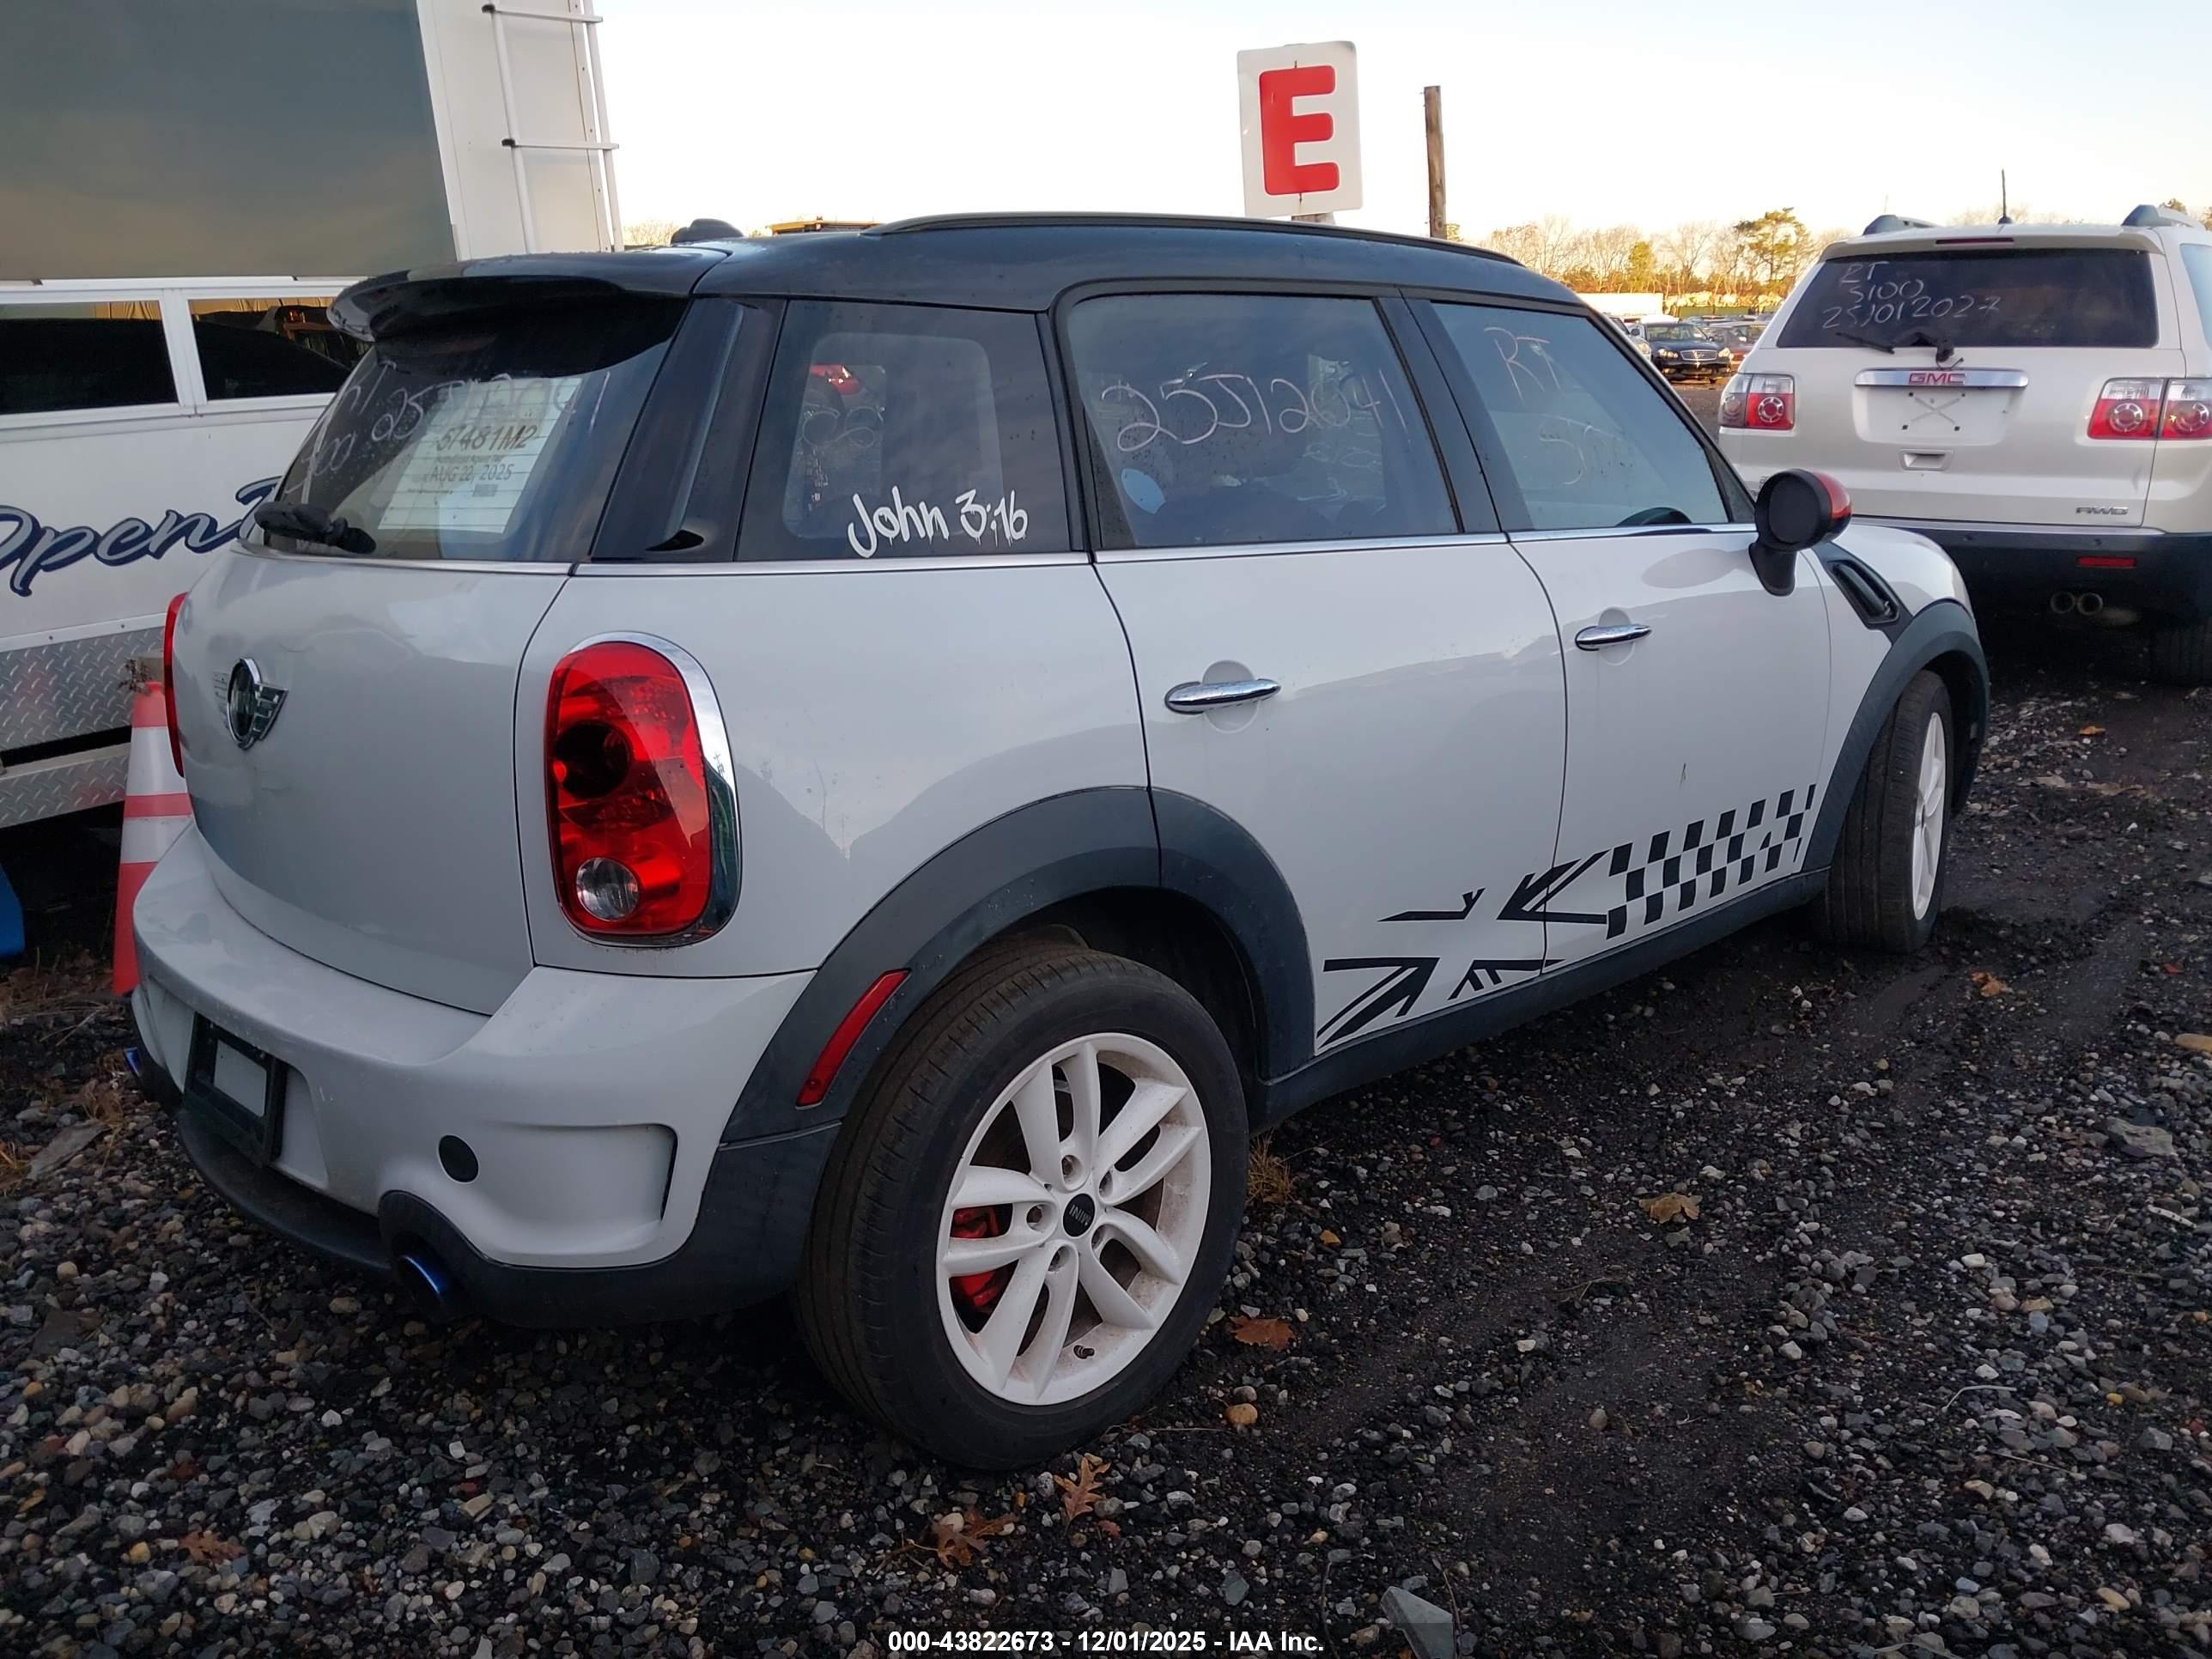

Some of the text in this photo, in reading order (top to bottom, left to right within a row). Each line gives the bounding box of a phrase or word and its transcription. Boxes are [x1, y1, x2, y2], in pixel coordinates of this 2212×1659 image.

[1259, 65, 1340, 196] E
[1909, 373, 1966, 385] GMC
[428, 465, 458, 483] AUG
[478, 464, 515, 482] 2025
[847, 485, 1029, 558] John 3:16
[1068, 1204, 1091, 1225] MINI
